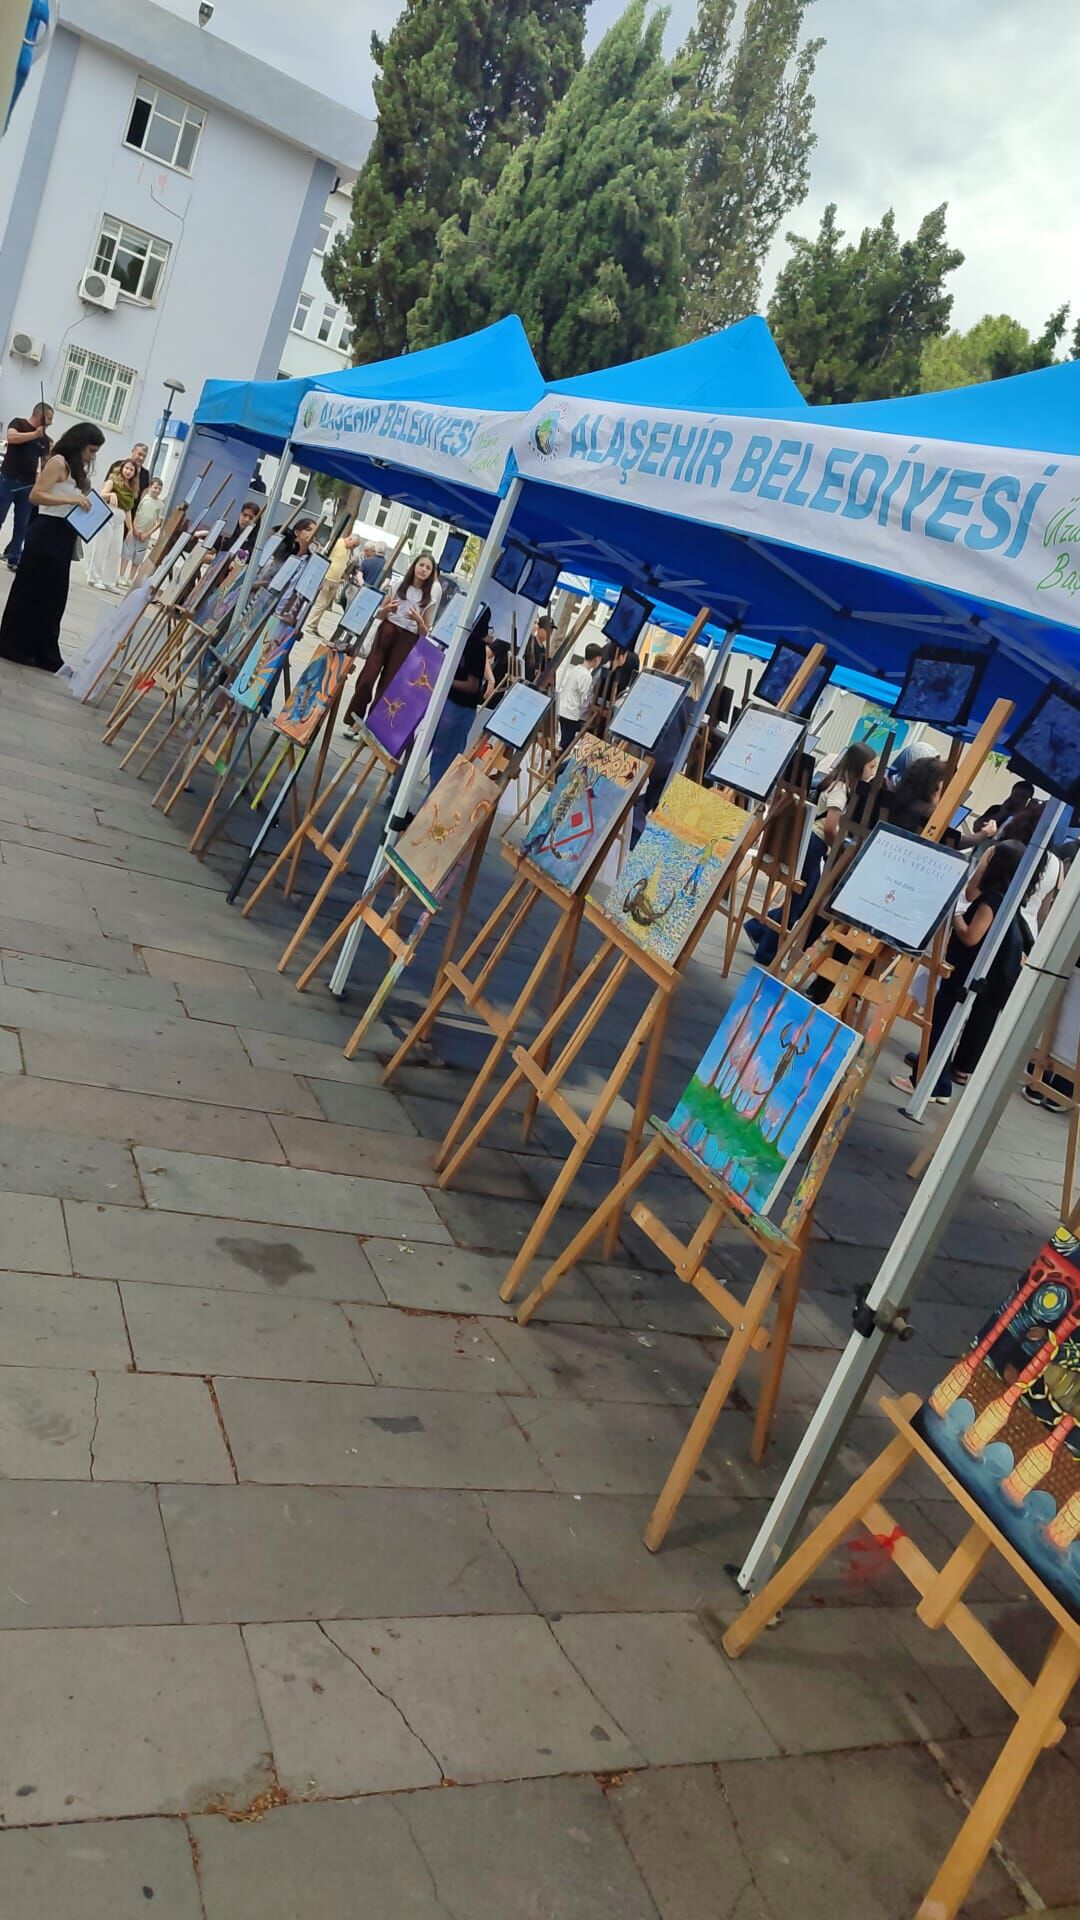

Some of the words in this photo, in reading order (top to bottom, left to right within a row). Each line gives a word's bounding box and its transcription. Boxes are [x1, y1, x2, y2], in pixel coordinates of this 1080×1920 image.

[378, 403, 485, 457] BELEDİYESİ
[569, 413, 733, 488] ALAŞEHİR
[730, 435, 1060, 559] BELEDİYESİ
